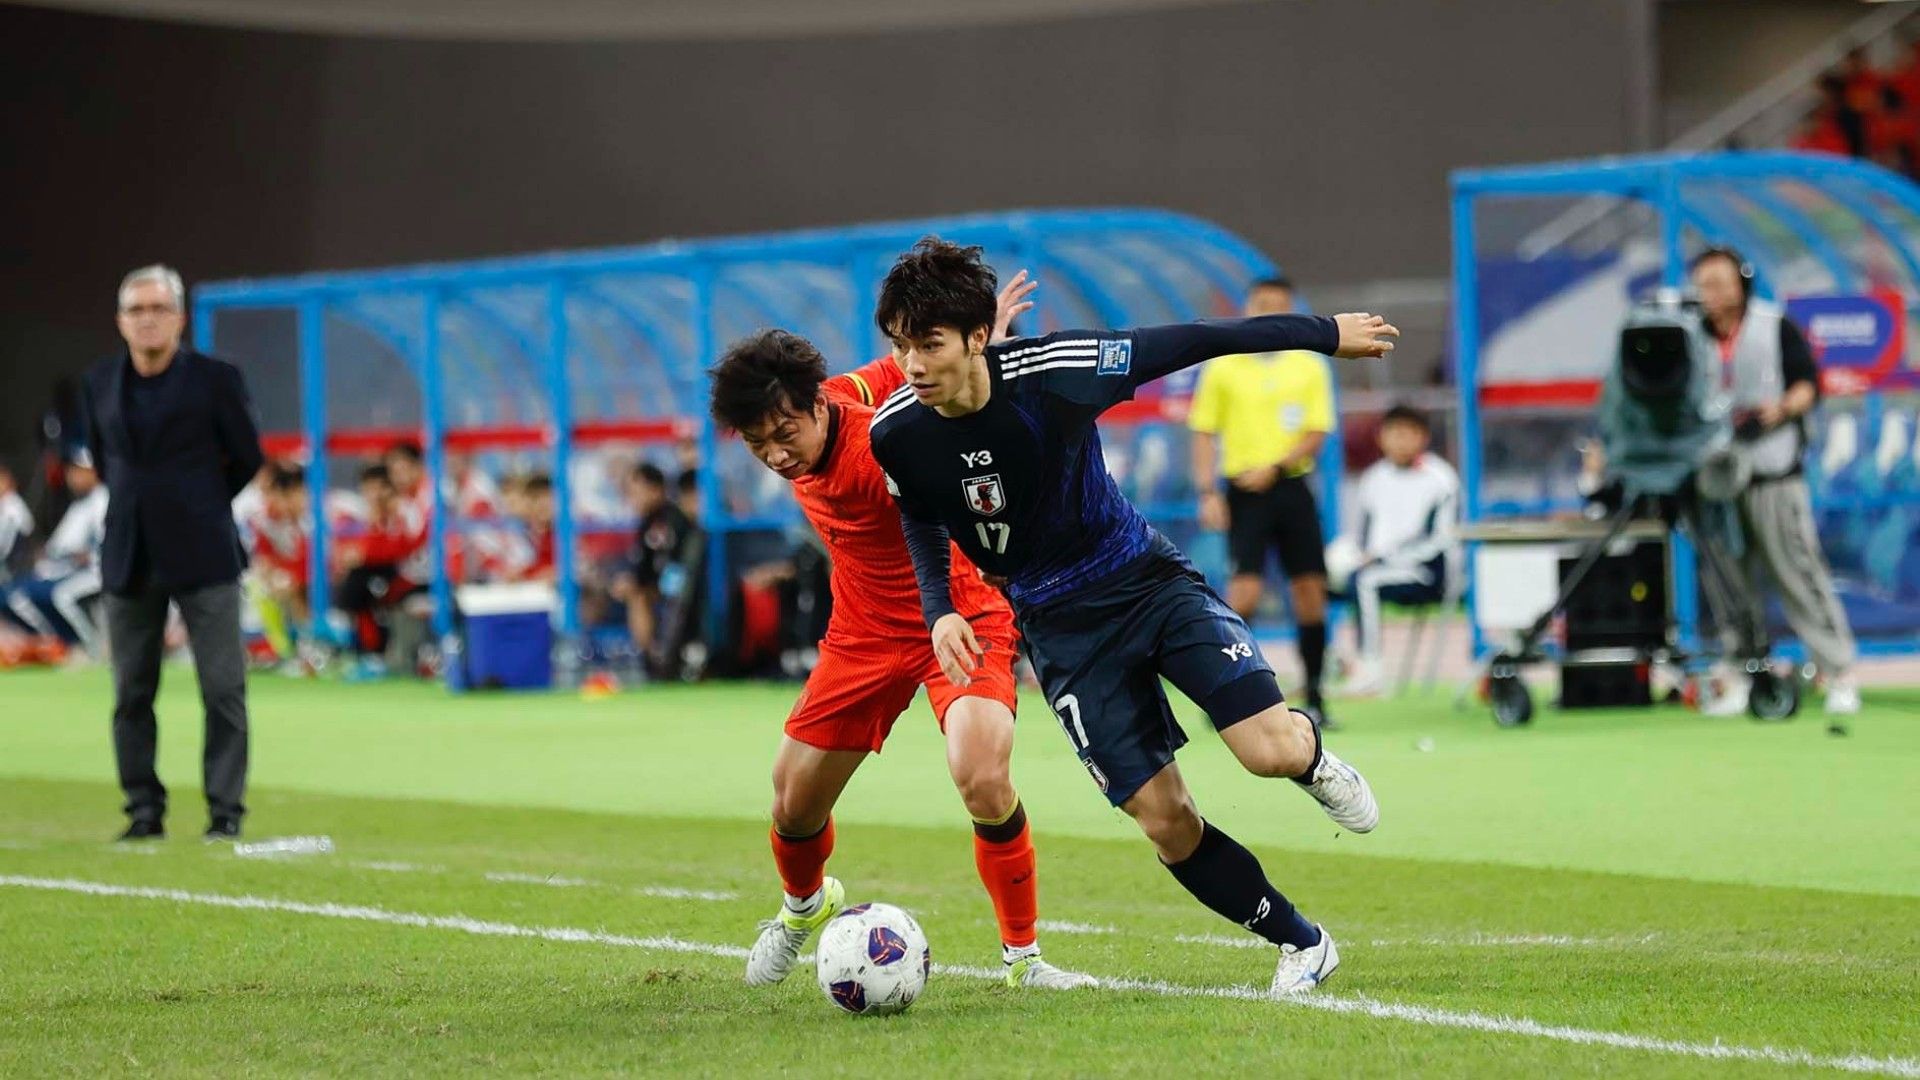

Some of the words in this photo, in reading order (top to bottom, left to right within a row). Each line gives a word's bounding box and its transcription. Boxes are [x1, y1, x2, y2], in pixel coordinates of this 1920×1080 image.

[960, 450, 993, 468] Y-3
[975, 522, 1010, 554] 17
[1221, 642, 1253, 662] Y-3
